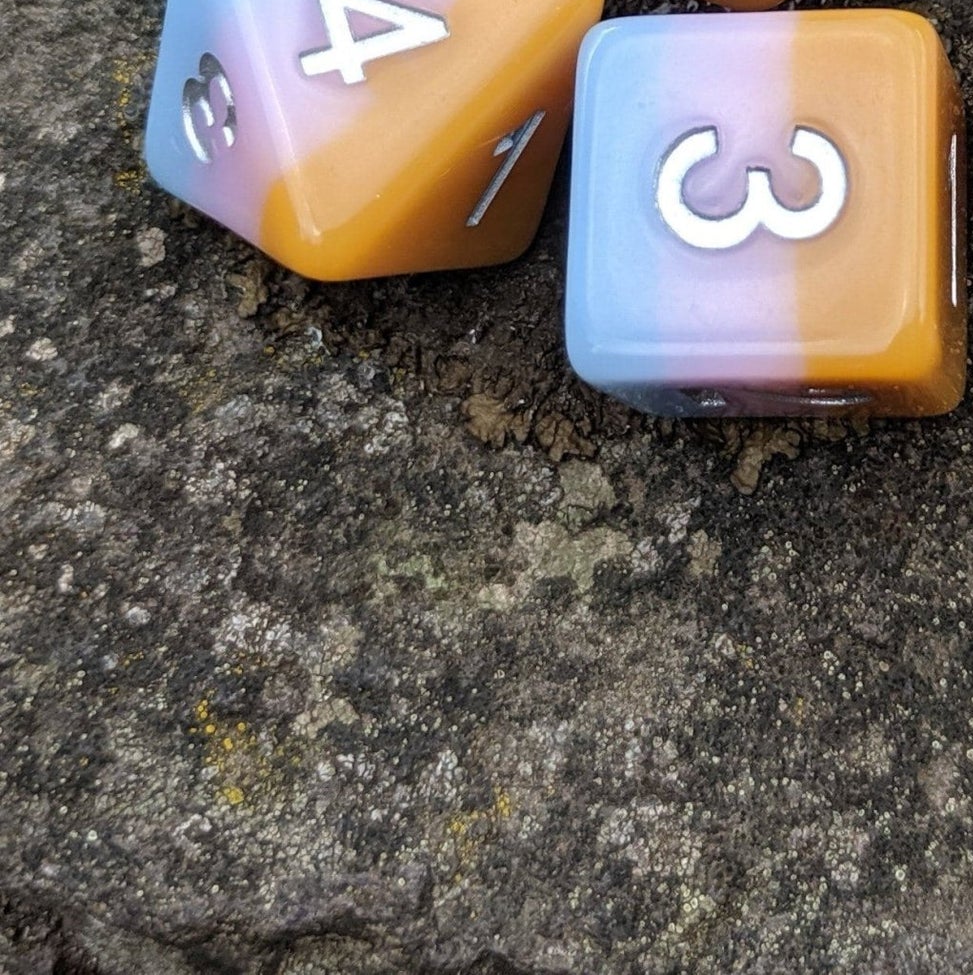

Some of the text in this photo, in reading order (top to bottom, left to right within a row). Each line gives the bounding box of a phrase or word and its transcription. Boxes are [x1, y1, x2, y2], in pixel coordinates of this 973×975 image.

[182, 52, 238, 165] 3
[466, 110, 546, 228] 1
[654, 125, 849, 251] 3
